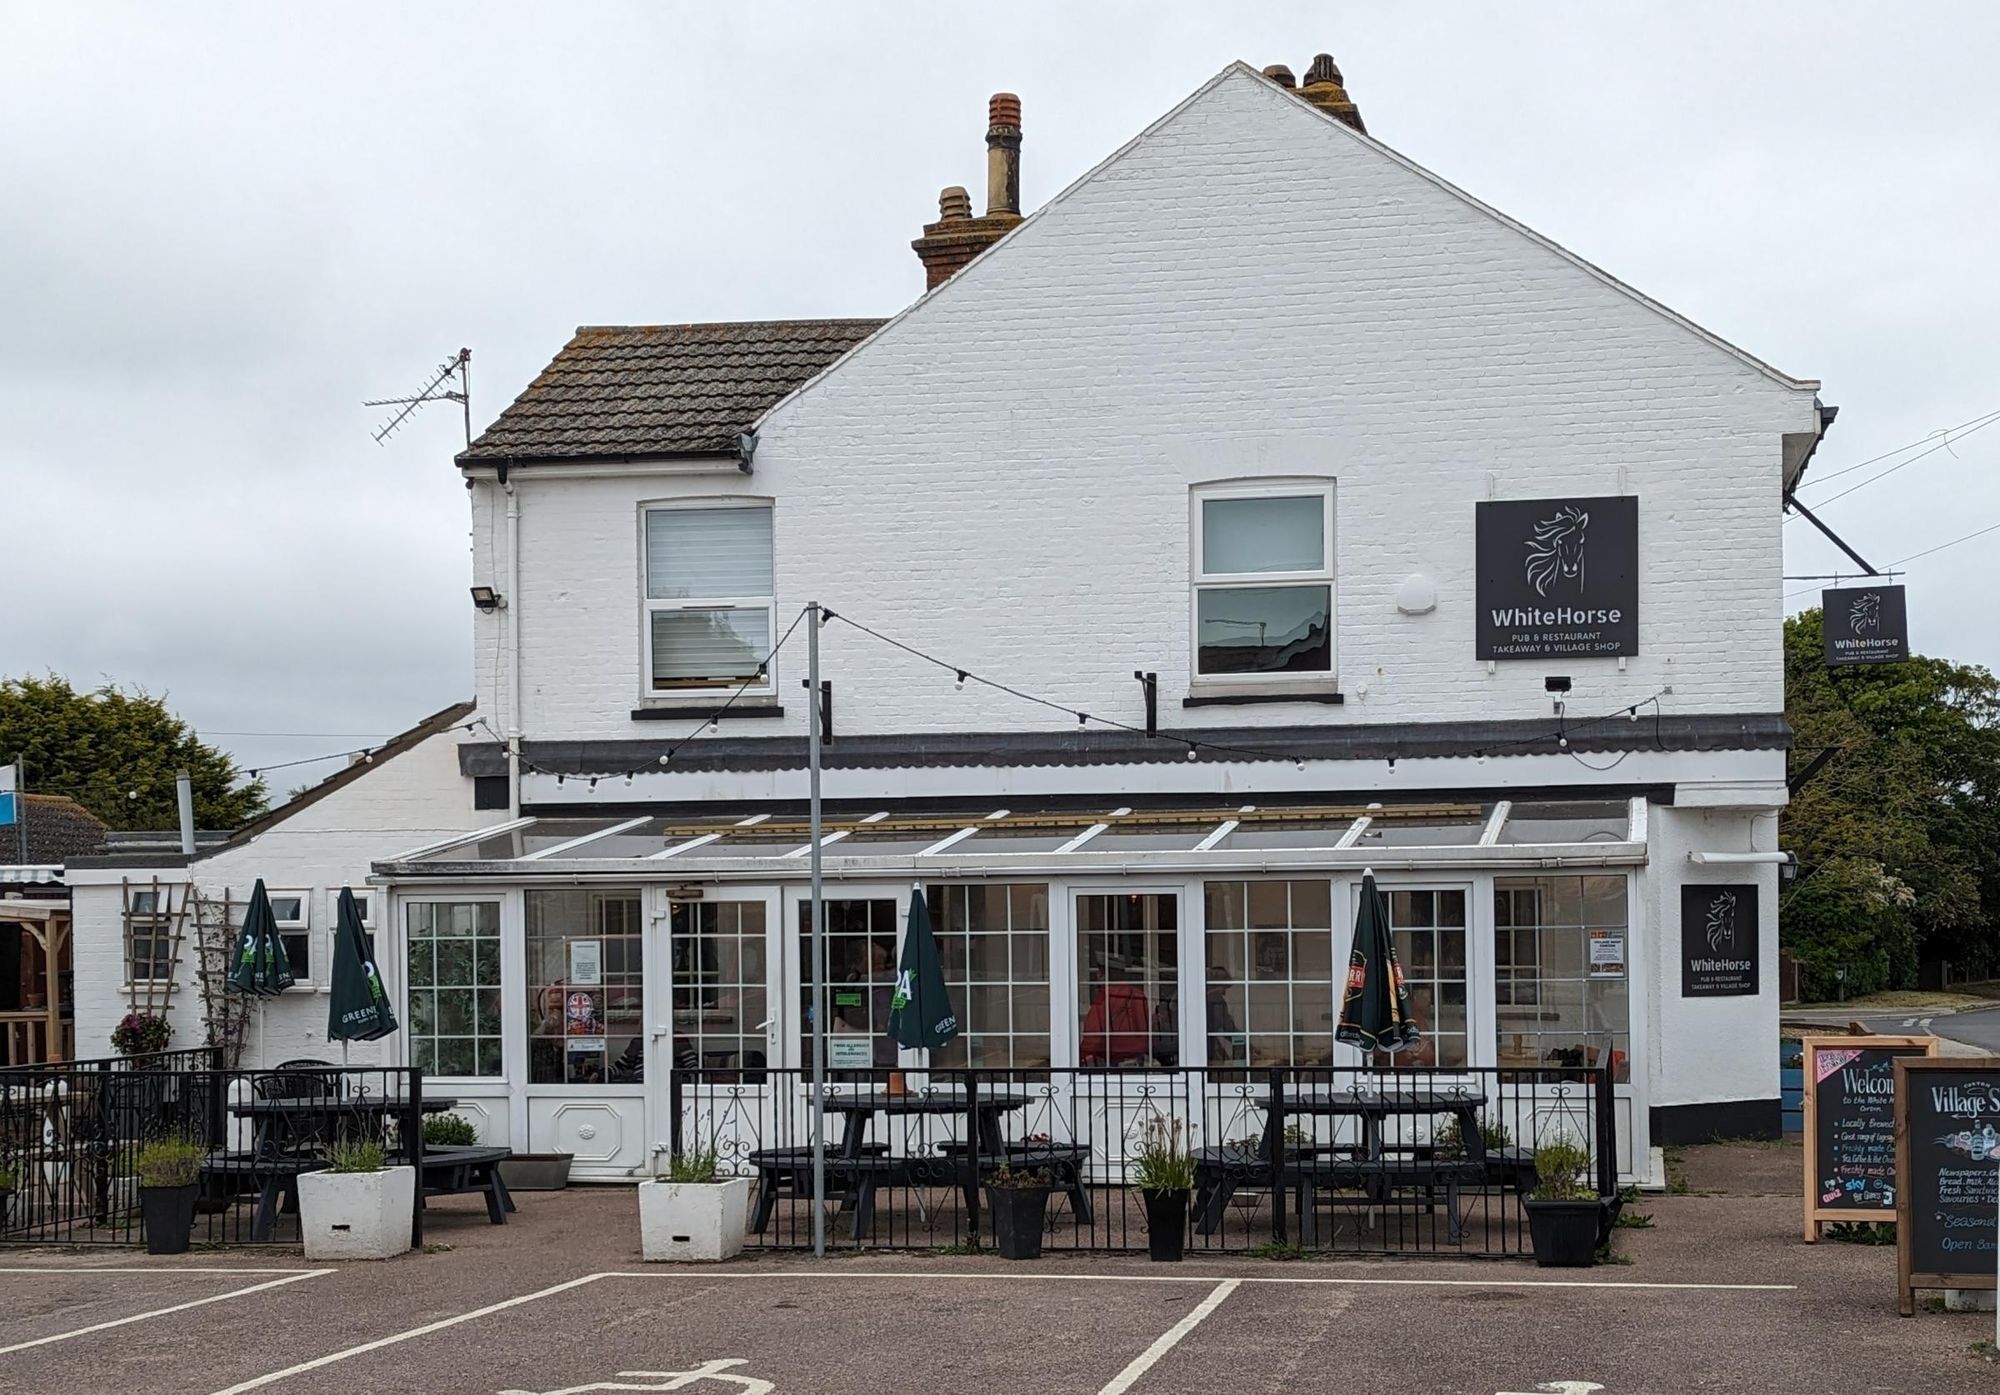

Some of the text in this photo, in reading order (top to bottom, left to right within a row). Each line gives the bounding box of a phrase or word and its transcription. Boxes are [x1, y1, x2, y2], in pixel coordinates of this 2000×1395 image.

[1491, 606, 1621, 627] WhiteHorse
[1511, 633, 1530, 642] PUB
[1542, 631, 1602, 642] RESTAURANT
[1492, 645, 1542, 654] TAKEAWAY
[1553, 642, 1591, 652] VILLAGE
[1594, 641, 1622, 651] SHOP
[1834, 638, 1899, 649] WhiteHorse
[1690, 958, 1751, 972] WhiteHorse
[1931, 1086, 1987, 1119] Village
[1939, 1185, 1962, 1195] Fresh
[1942, 1236, 1973, 1252] Open
